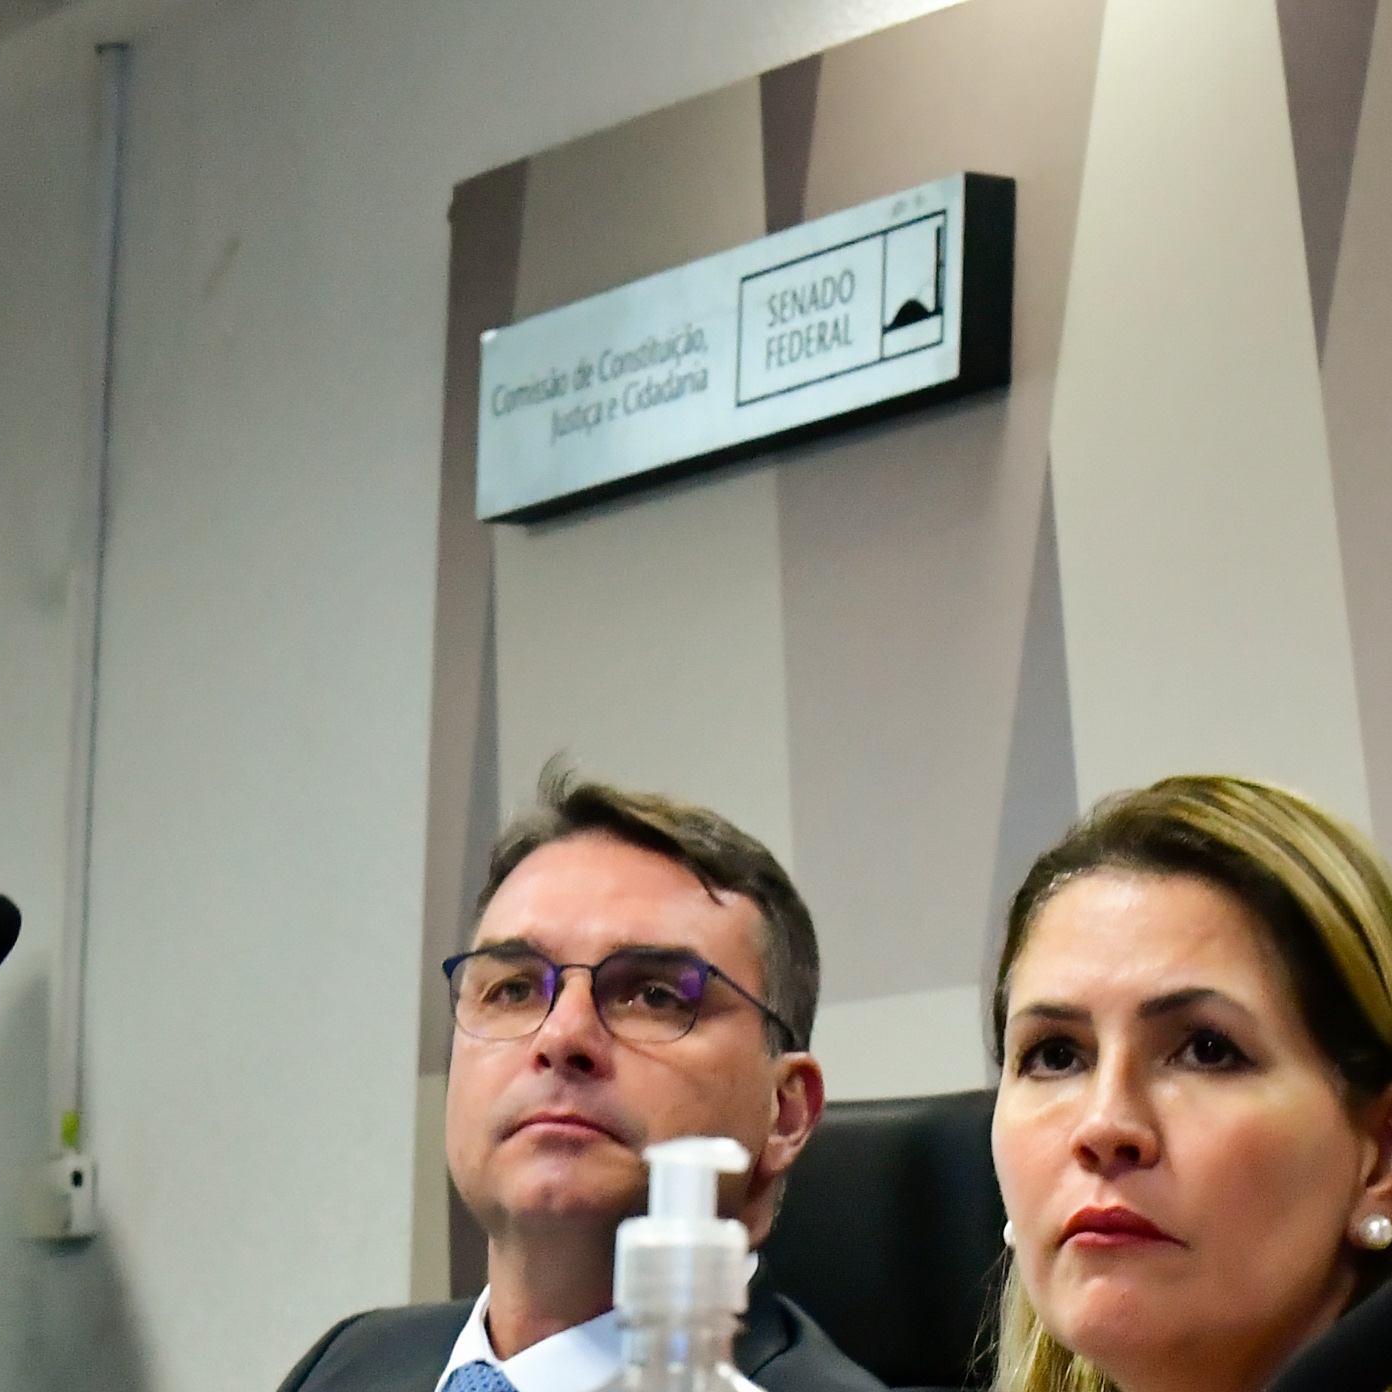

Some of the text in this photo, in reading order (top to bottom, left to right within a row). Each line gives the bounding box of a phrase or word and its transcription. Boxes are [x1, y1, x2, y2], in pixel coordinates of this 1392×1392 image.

[766, 268, 855, 327] SENADO
[765, 313, 853, 371] FEDERAL
[492, 366, 569, 417] Comissão
[572, 357, 595, 390] de
[550, 361, 708, 446] Justiça e Cidadania
